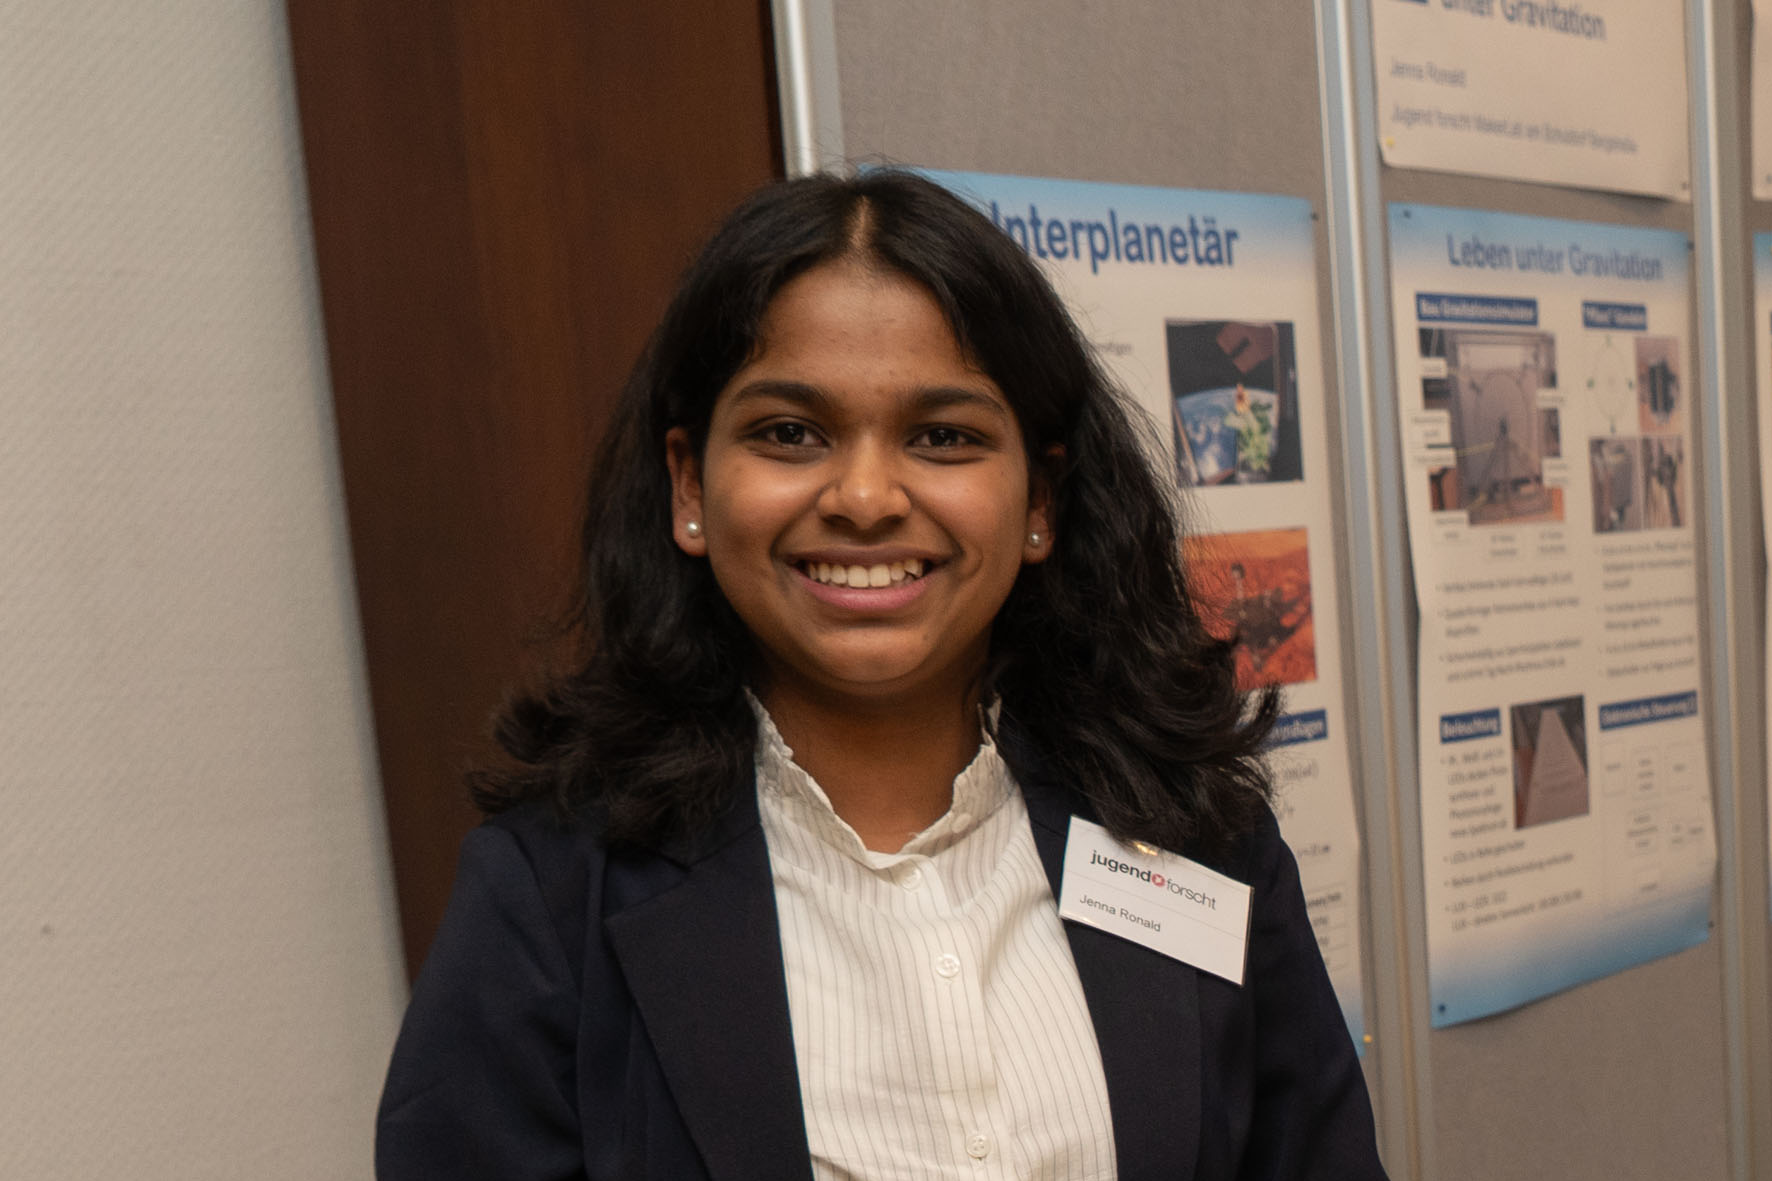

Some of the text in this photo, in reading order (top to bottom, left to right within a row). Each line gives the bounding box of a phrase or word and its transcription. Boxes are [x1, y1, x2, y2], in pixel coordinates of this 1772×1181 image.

[1501, 0, 1606, 40] Gravitation
[992, 199, 1238, 275] Interplanetär
[1447, 233, 1664, 280] Leben unter Gravitation
[1090, 850, 1216, 910] jugend forscht
[1080, 894, 1161, 932] Jenna Ronald
